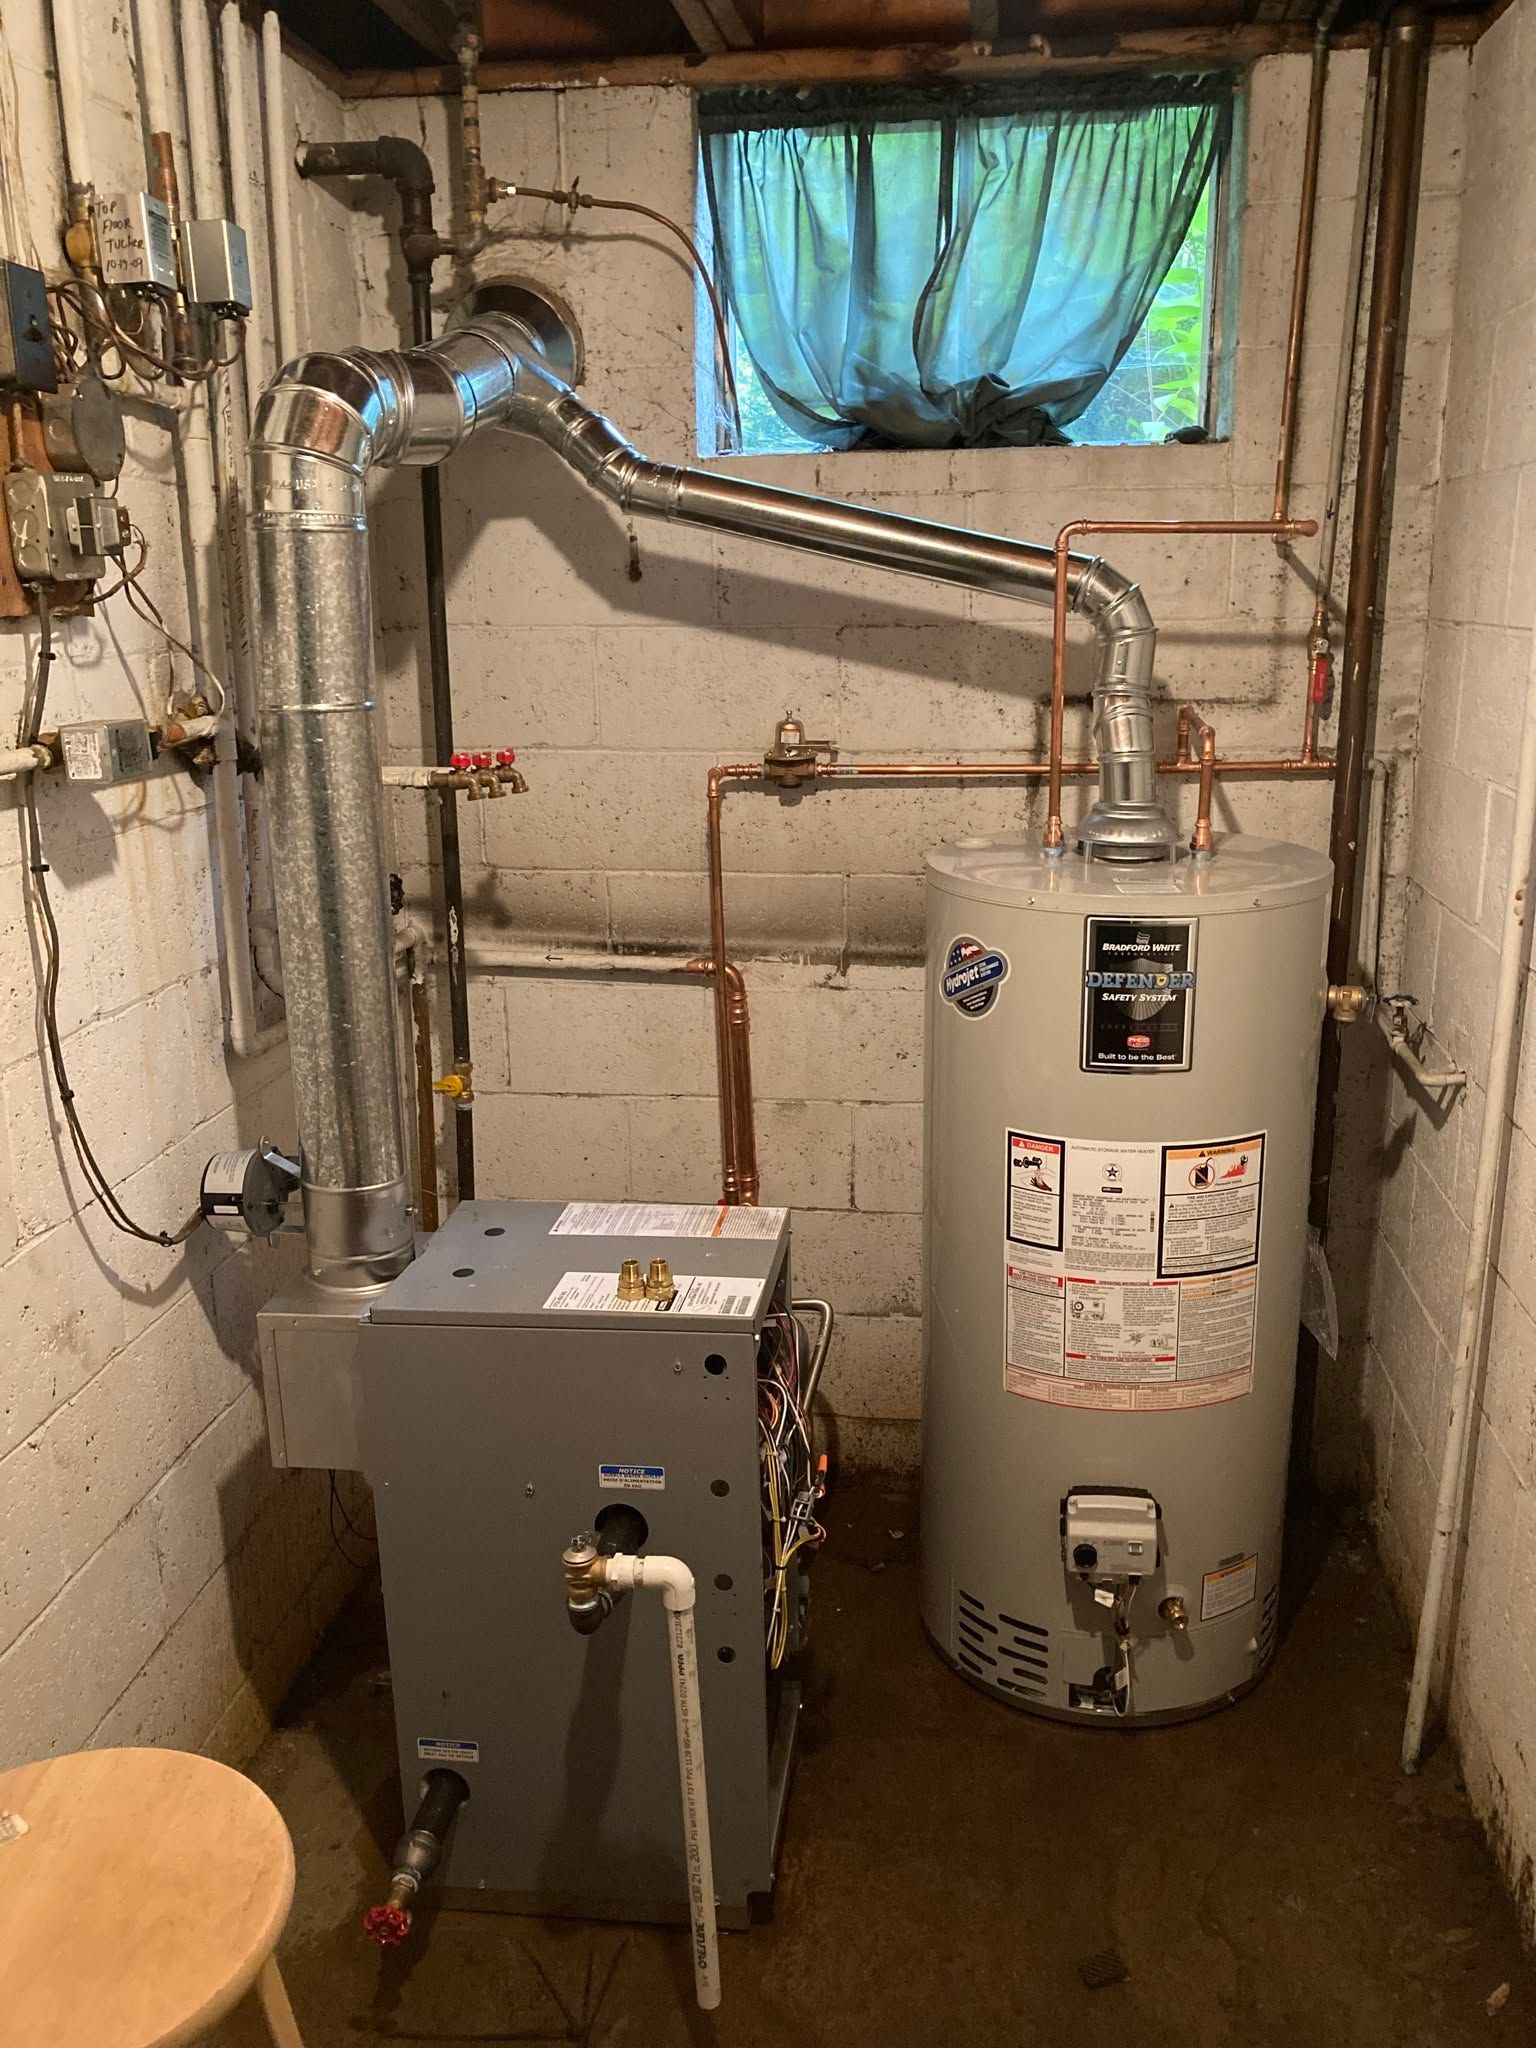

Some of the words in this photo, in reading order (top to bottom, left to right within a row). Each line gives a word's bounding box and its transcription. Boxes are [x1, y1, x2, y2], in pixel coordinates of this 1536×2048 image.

[95, 201, 117, 218] TOP
[1102, 943, 1150, 952] BRADFORD
[1152, 943, 1182, 951] WHITE
[945, 966, 980, 993] Hydrojet
[1087, 971, 1194, 989] DEFENDER
[1102, 993, 1137, 1001] SAFETY
[1139, 993, 1177, 1002] SYSTEM
[1098, 1052, 1116, 1060] Built
[1026, 1143, 1054, 1152] DANGER
[1206, 1147, 1236, 1156] WARNING
[677, 1653, 685, 1676] PPFA
[690, 1831, 698, 1841] PSI
[688, 1844, 700, 1863] 200
